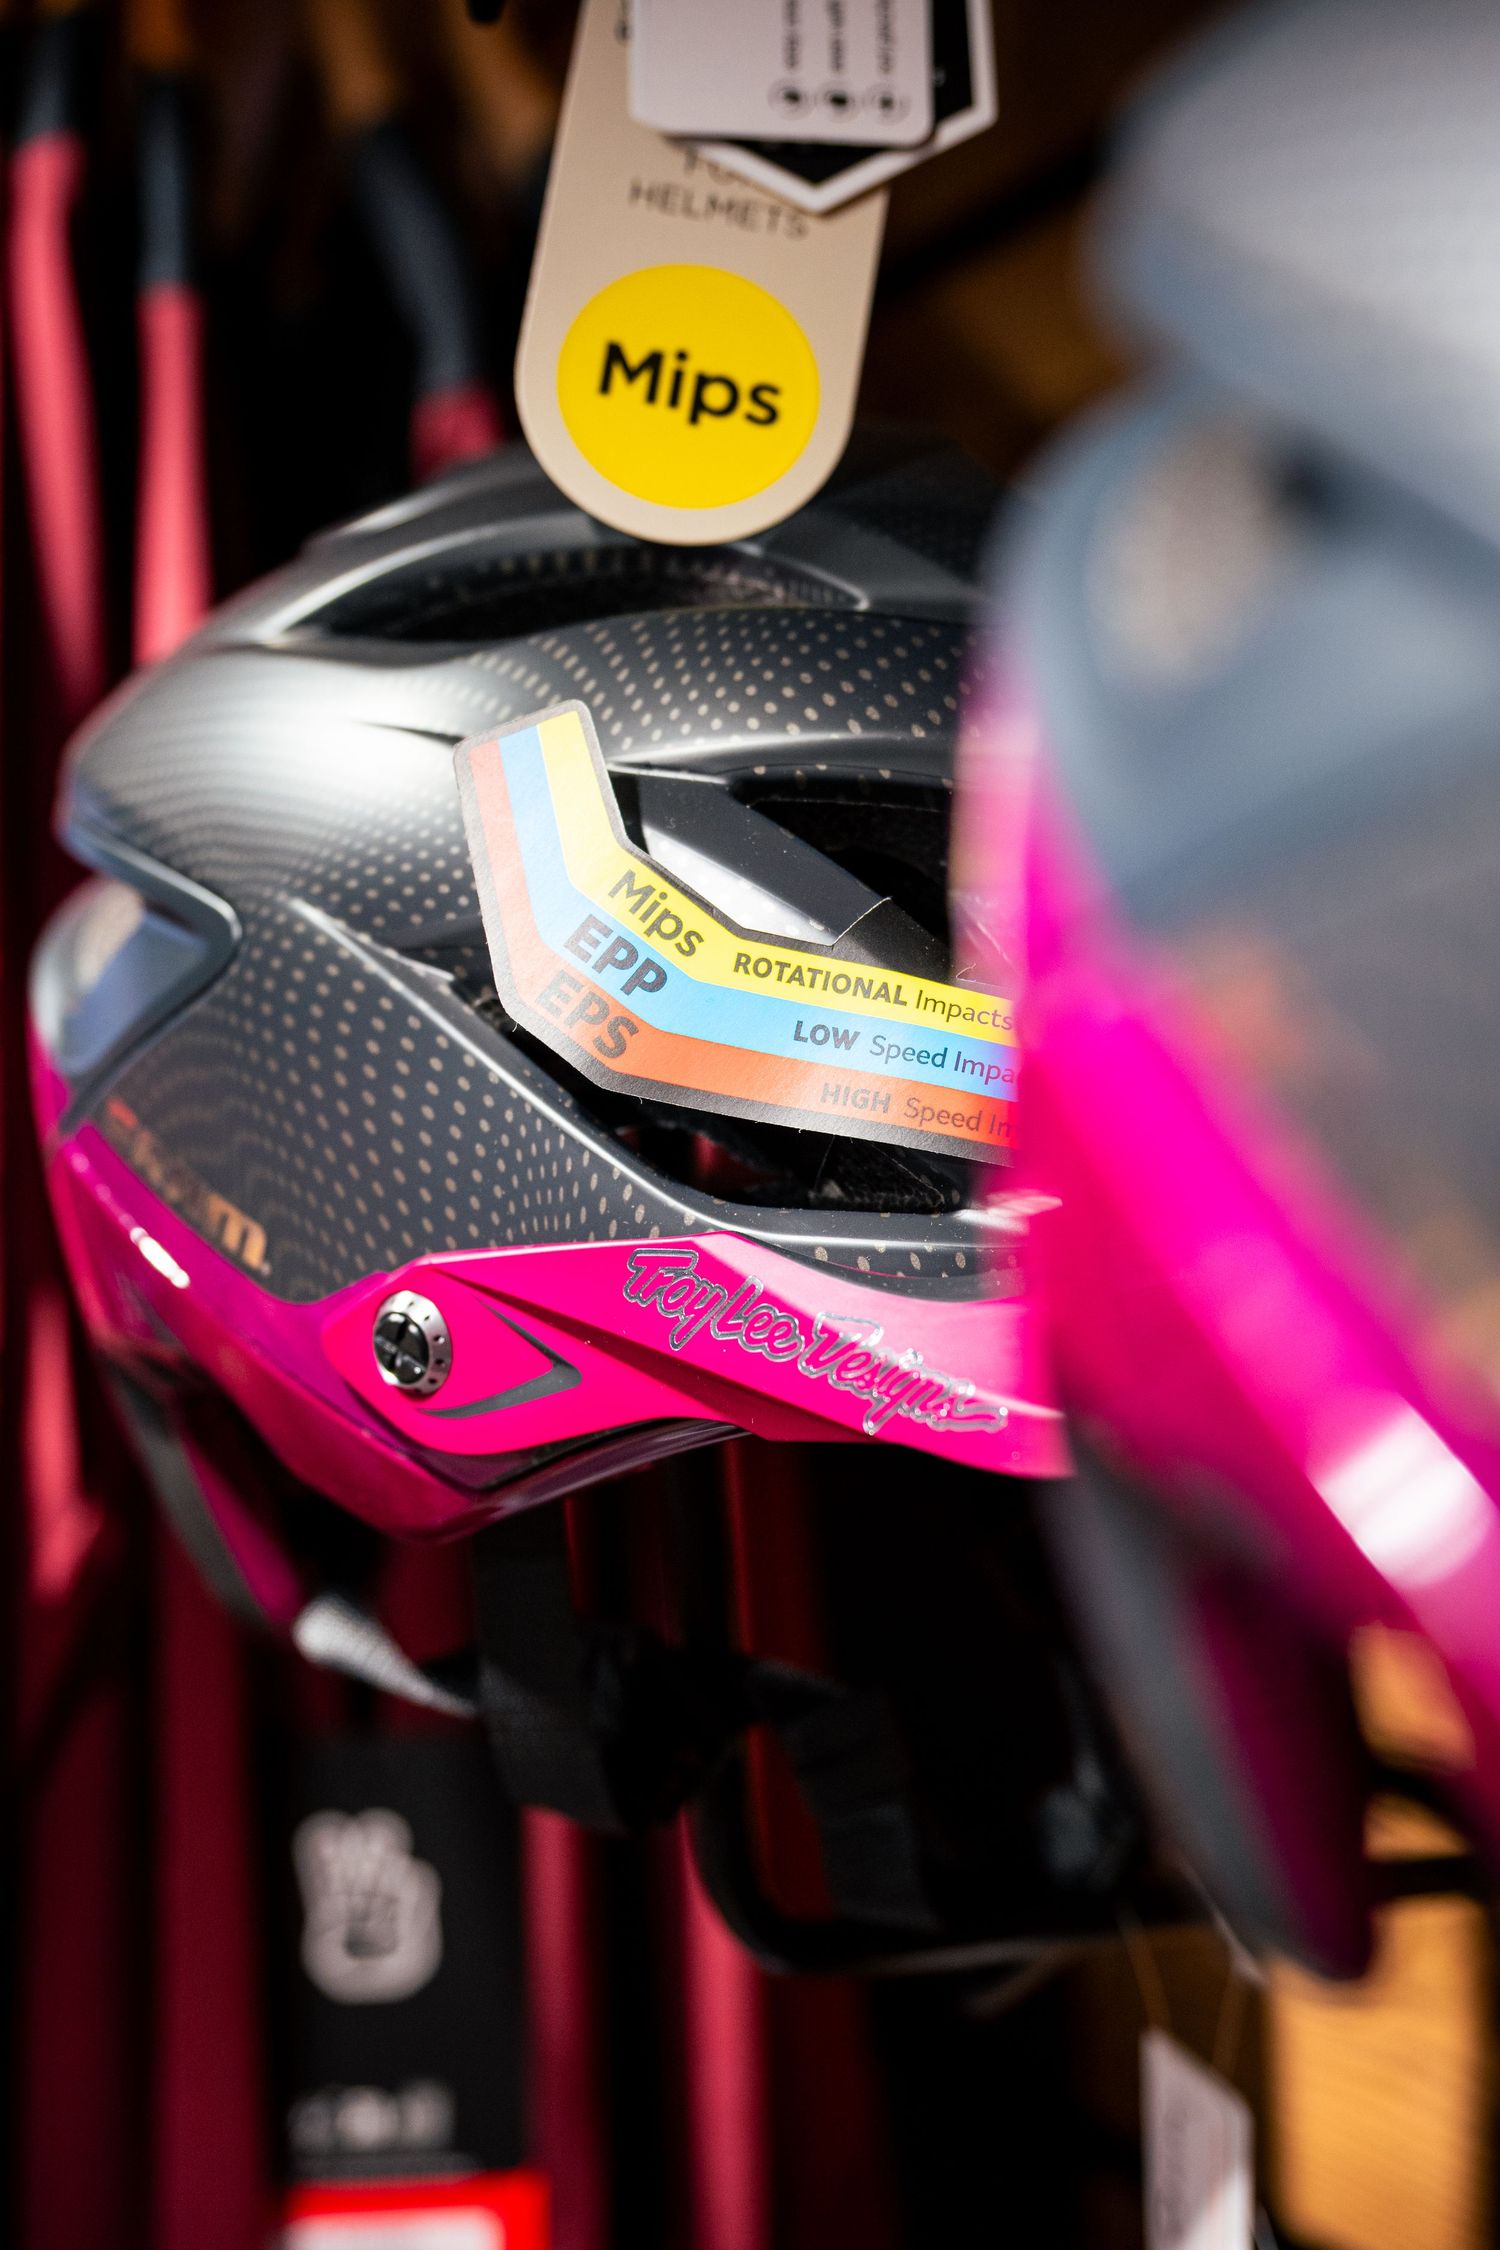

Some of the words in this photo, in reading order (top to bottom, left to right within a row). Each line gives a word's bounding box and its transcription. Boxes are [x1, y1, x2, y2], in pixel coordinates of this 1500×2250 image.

[628, 178, 808, 240] HELMETS
[598, 341, 782, 427] Mips
[563, 914, 668, 996] EPP
[608, 871, 704, 958] Mips
[534, 969, 639, 1060] EPS
[734, 953, 907, 1006] ROTATIONAL
[915, 990, 1014, 1031] Impacts
[793, 1020, 860, 1052] LOW
[869, 1034, 948, 1070] Speed
[820, 1082, 891, 1114] HIGH
[904, 1097, 983, 1132] Speed
[624, 1249, 727, 1350] Troy
[711, 1275, 804, 1362] Lee
[797, 1312, 1008, 1435] Designs
